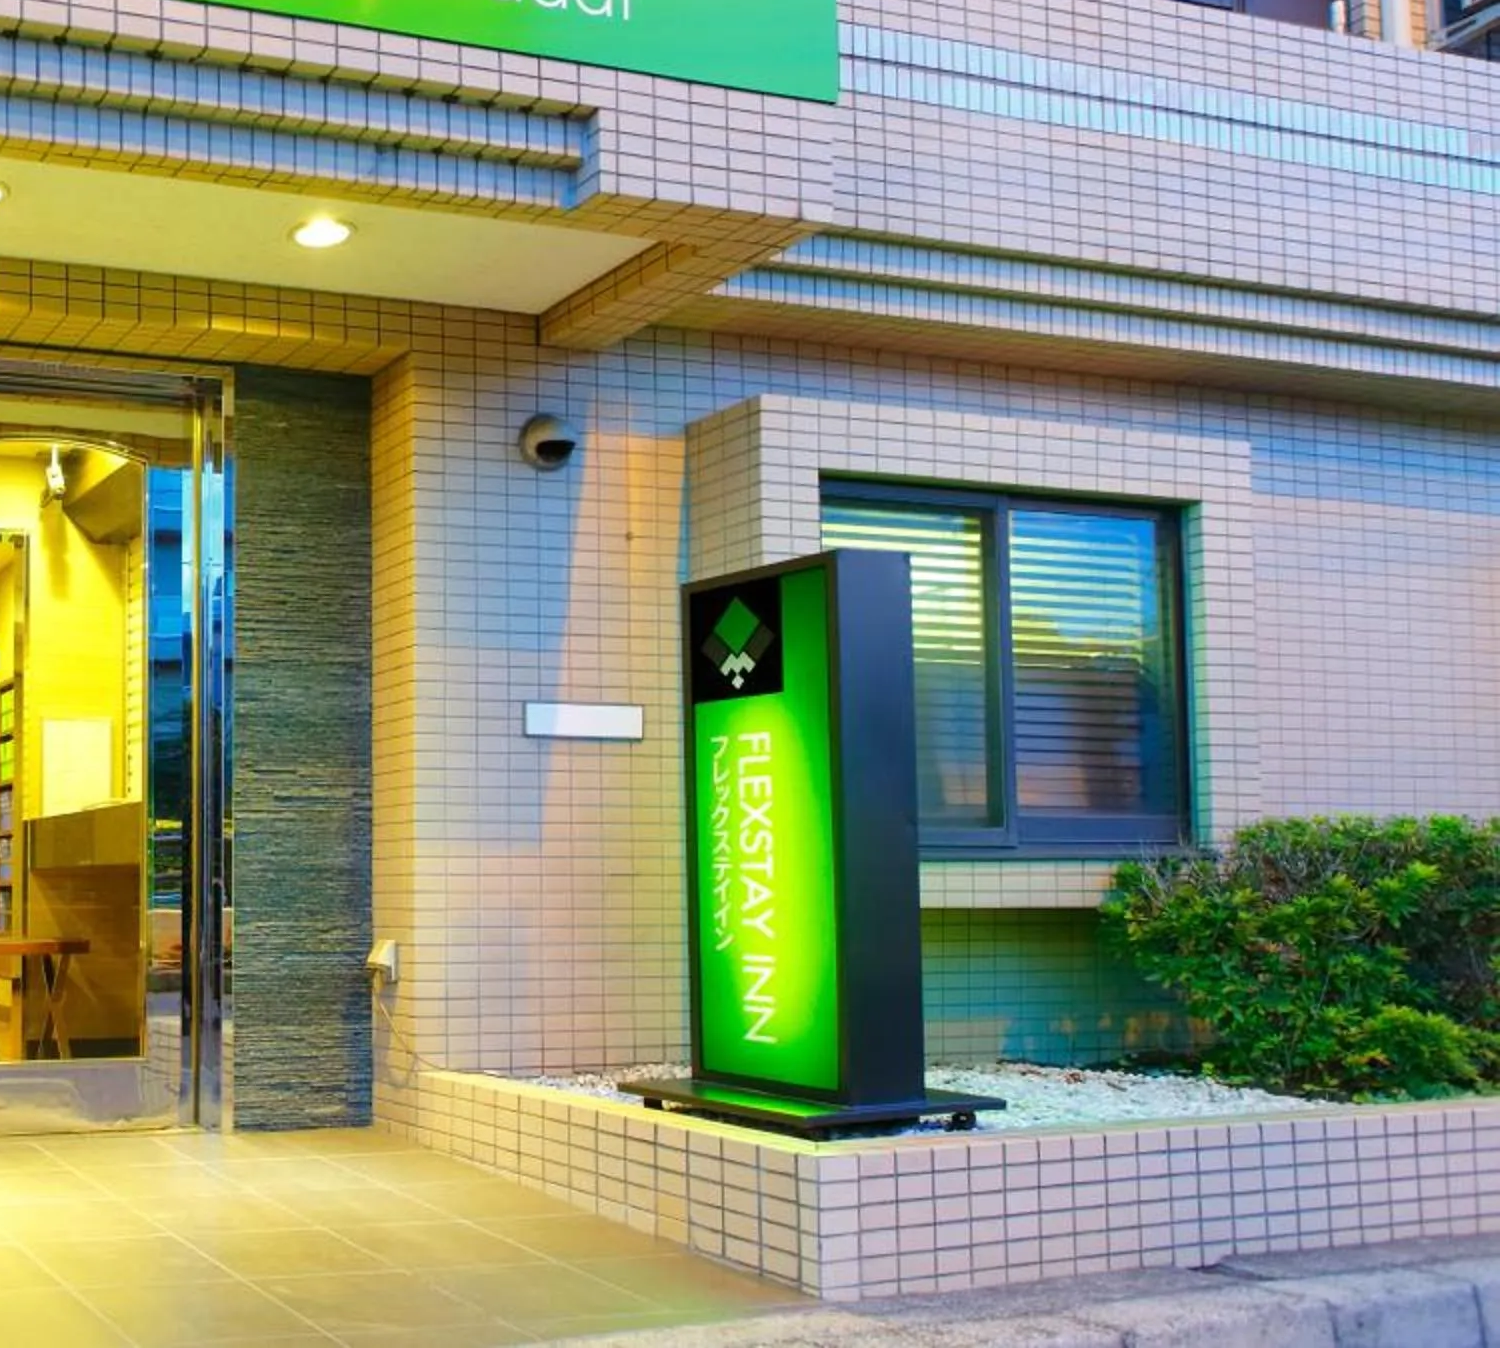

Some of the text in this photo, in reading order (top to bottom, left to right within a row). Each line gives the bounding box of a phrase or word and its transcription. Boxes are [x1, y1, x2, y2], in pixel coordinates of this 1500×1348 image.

[710, 736, 733, 950] フレックステイイン
[737, 731, 778, 1044] FLEXSTAY INN
